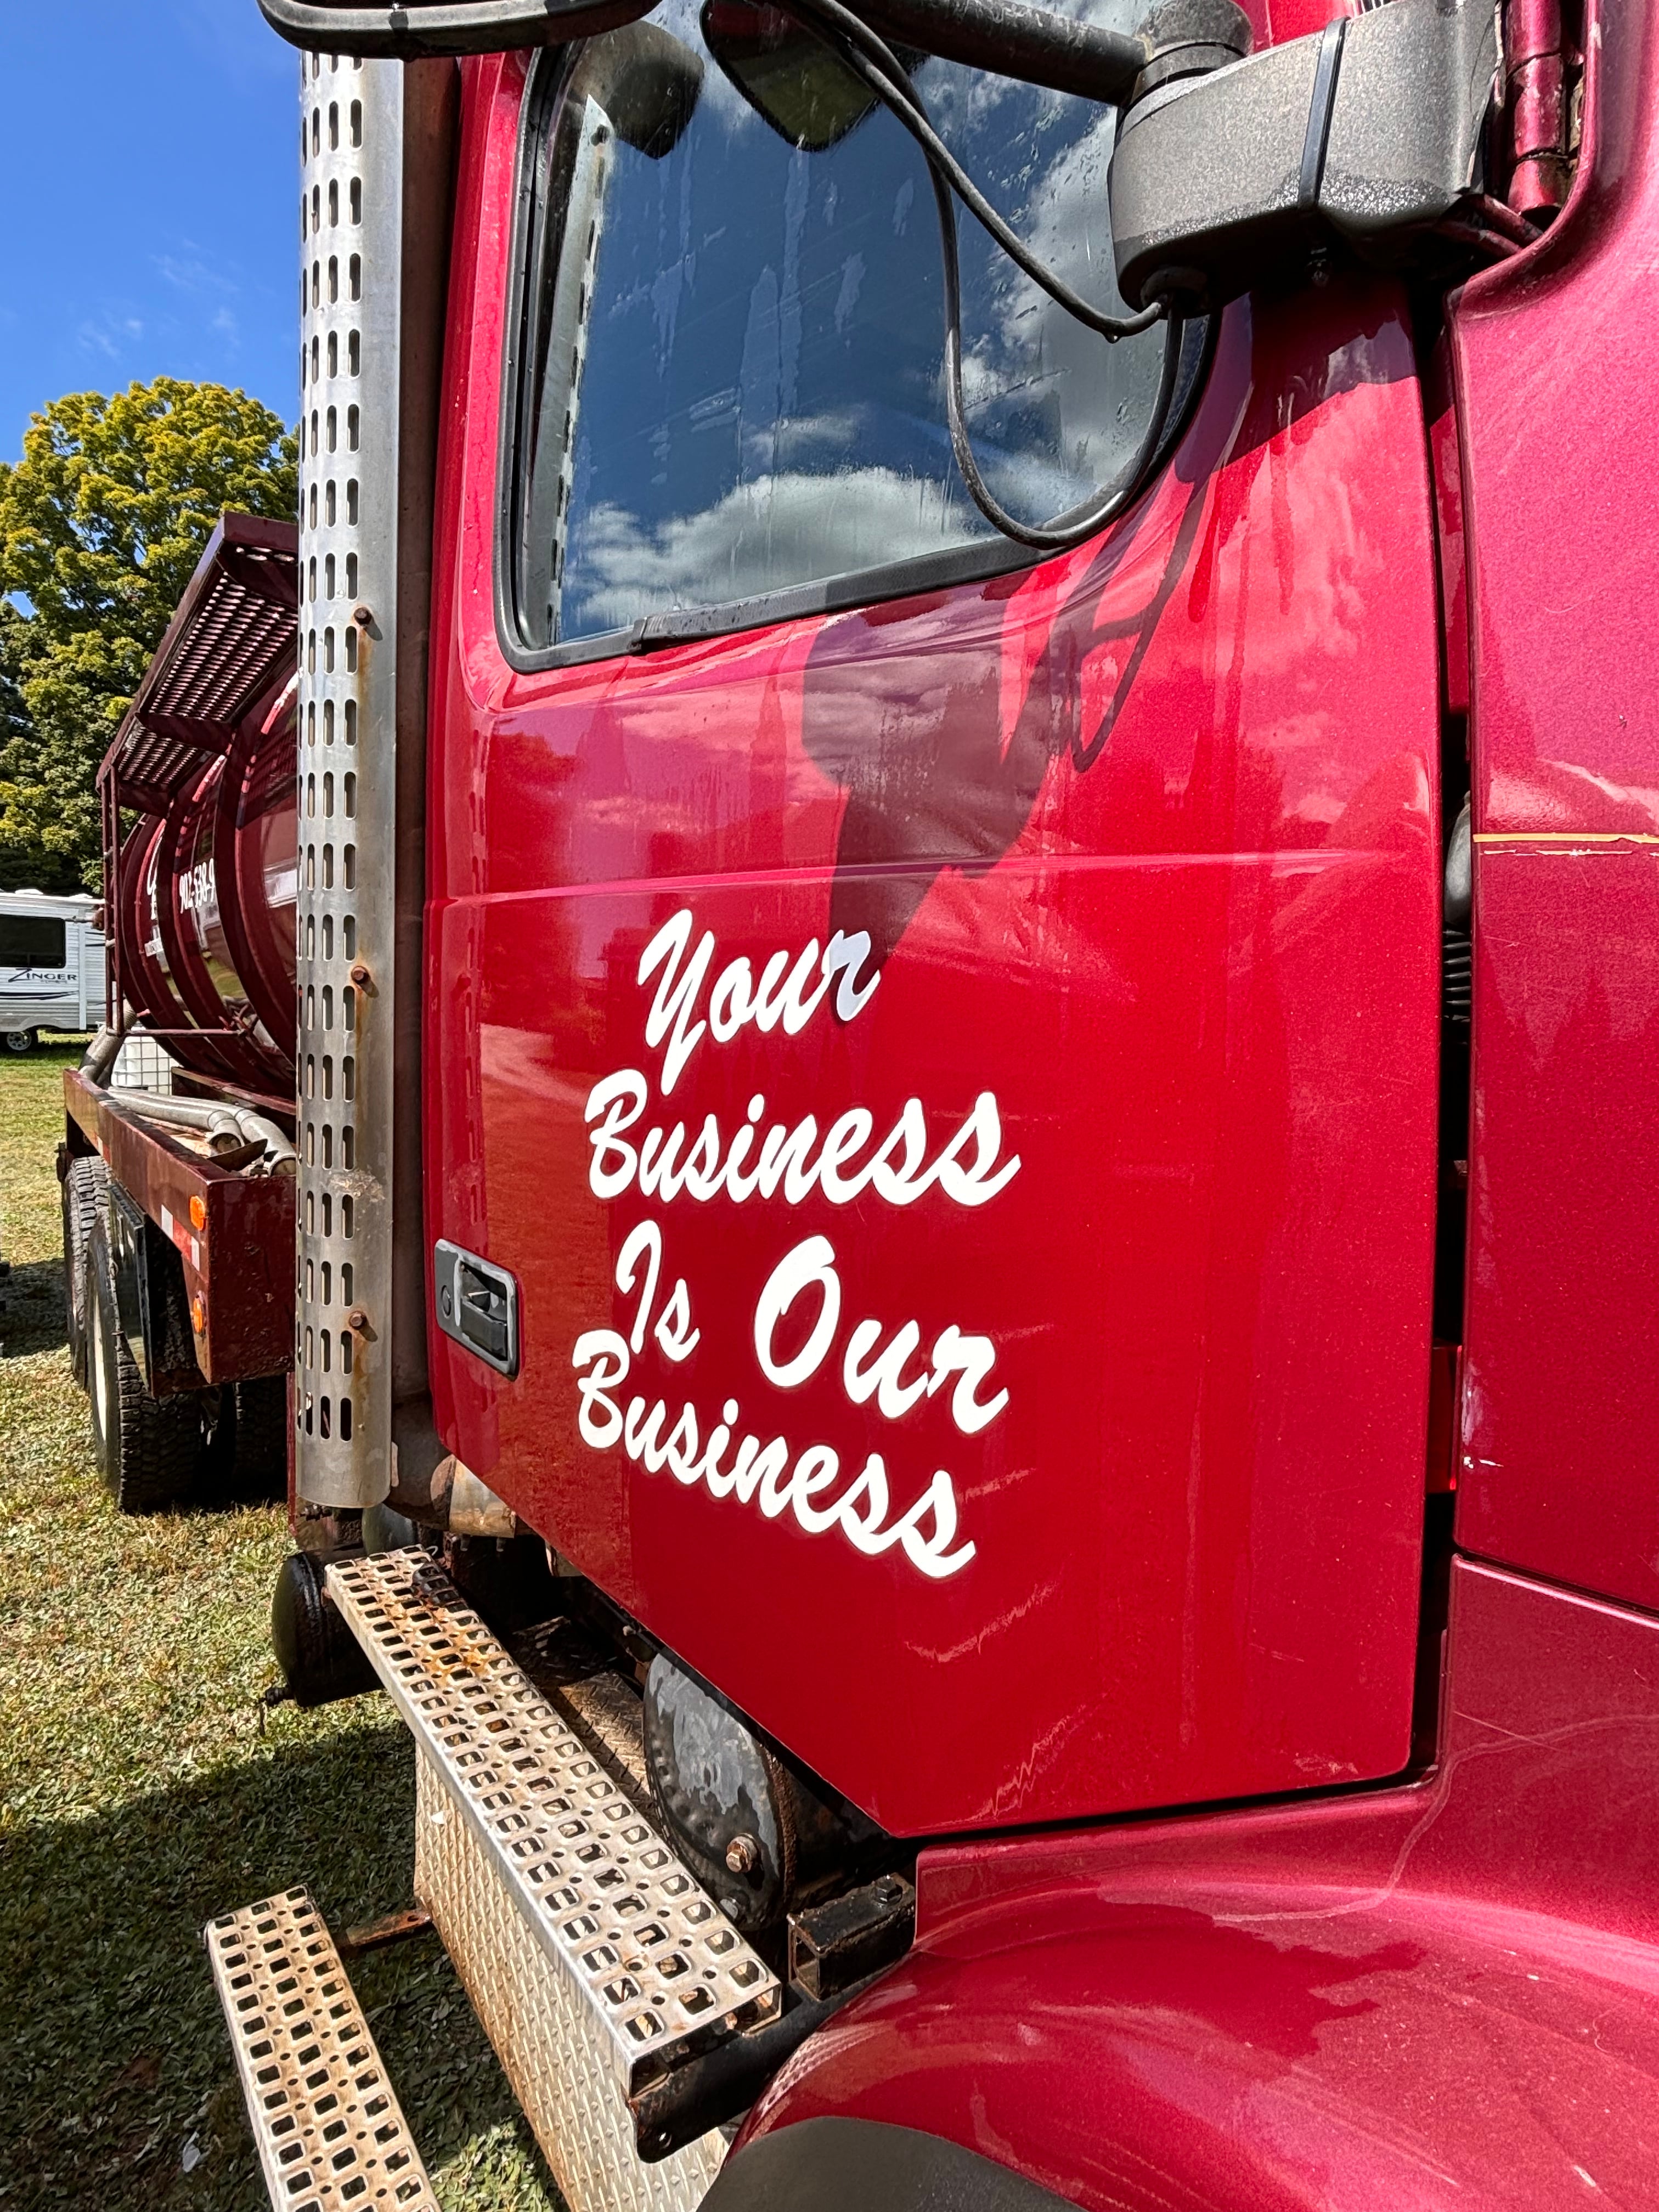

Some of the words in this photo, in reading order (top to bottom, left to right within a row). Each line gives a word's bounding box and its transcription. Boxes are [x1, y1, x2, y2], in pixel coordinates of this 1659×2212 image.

[8, 968, 77, 983] ZINGER
[637, 909, 881, 1096] Your
[584, 1069, 1022, 1207] Business
[616, 1220, 700, 1362] Is
[754, 1235, 1009, 1434] Our
[572, 1329, 976, 1579] Business
